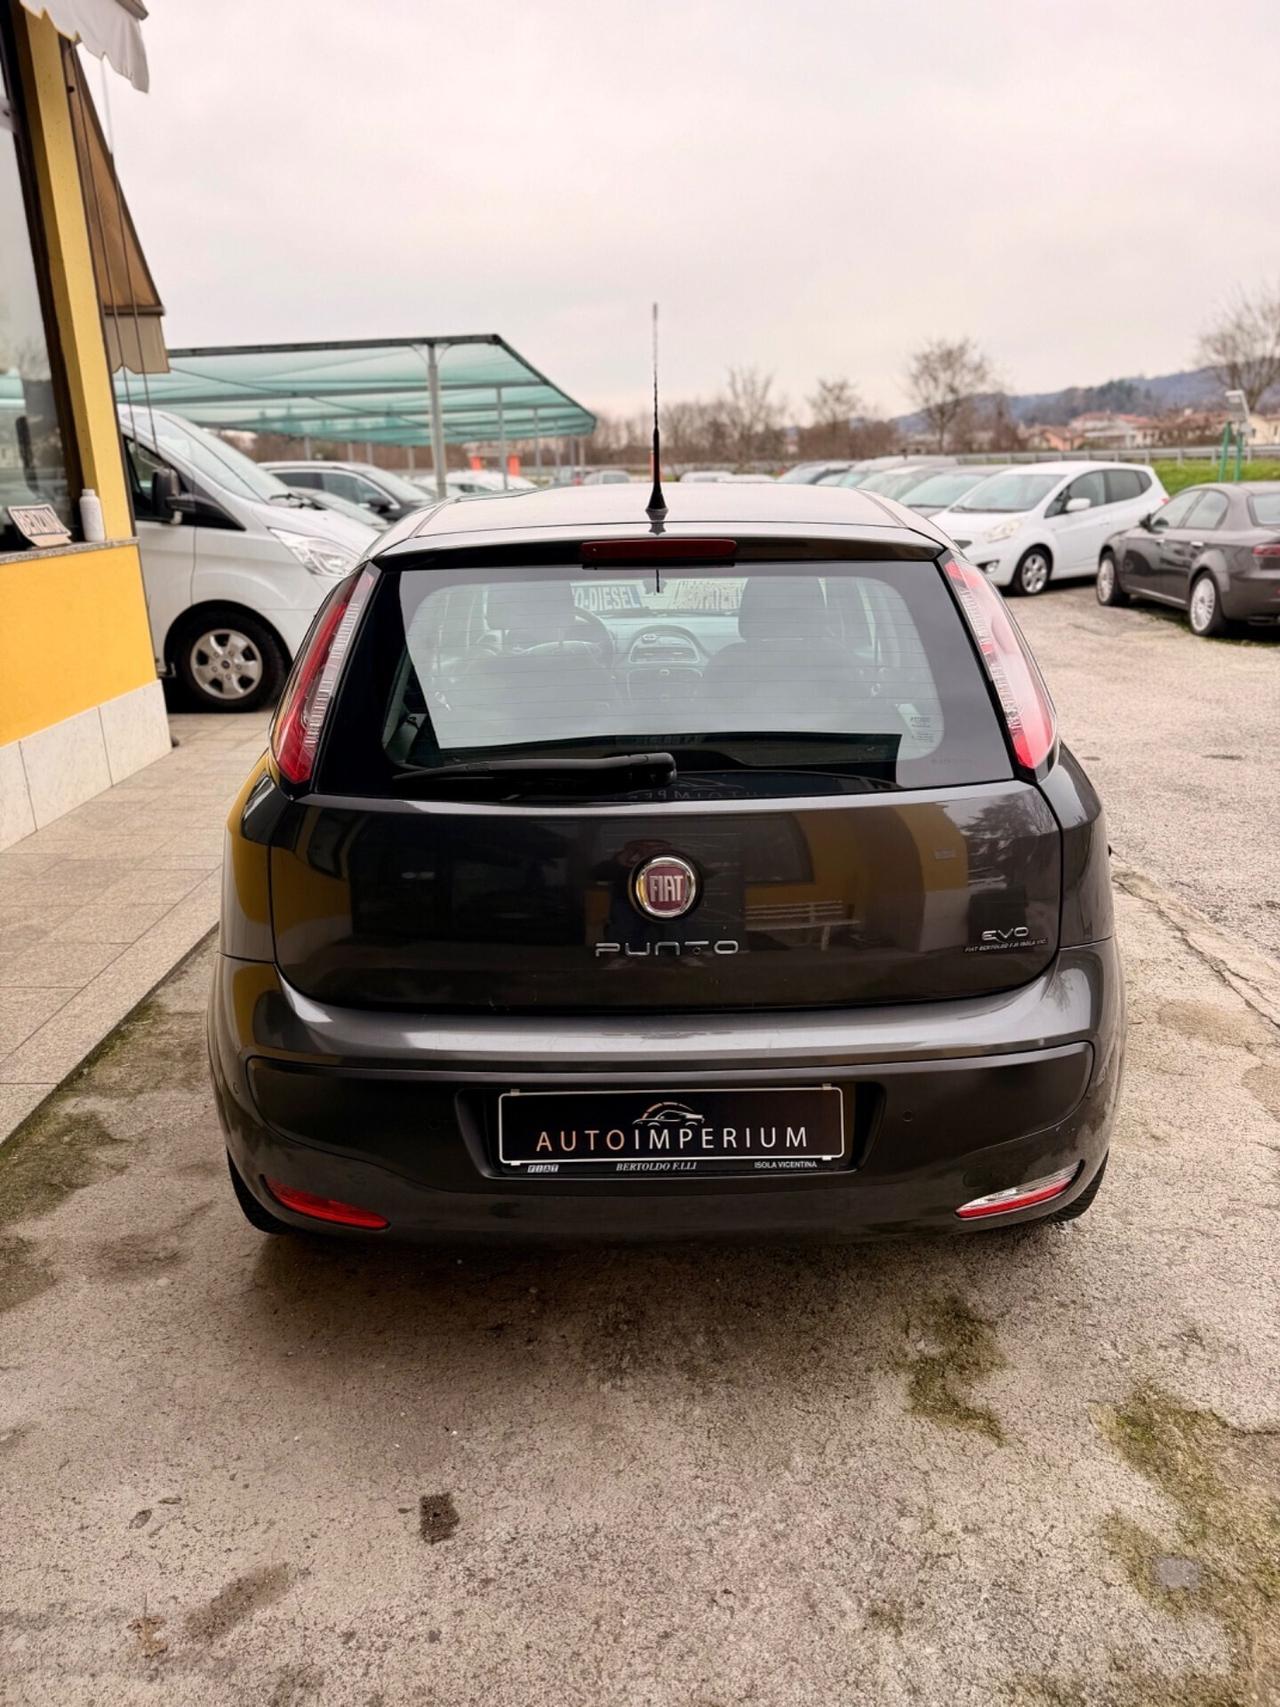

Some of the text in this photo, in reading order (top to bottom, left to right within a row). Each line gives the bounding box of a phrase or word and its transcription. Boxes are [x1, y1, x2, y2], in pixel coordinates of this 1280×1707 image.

[650, 875, 684, 902] FIAT
[982, 926, 1029, 942] EVO
[595, 940, 739, 957] PUNTO
[536, 1126, 808, 1152] AUTOIMPERIUM
[615, 1162, 671, 1172] BERTOLDO
[753, 1161, 778, 1169] ISOLA
[777, 1160, 818, 1169] VICENTINA
